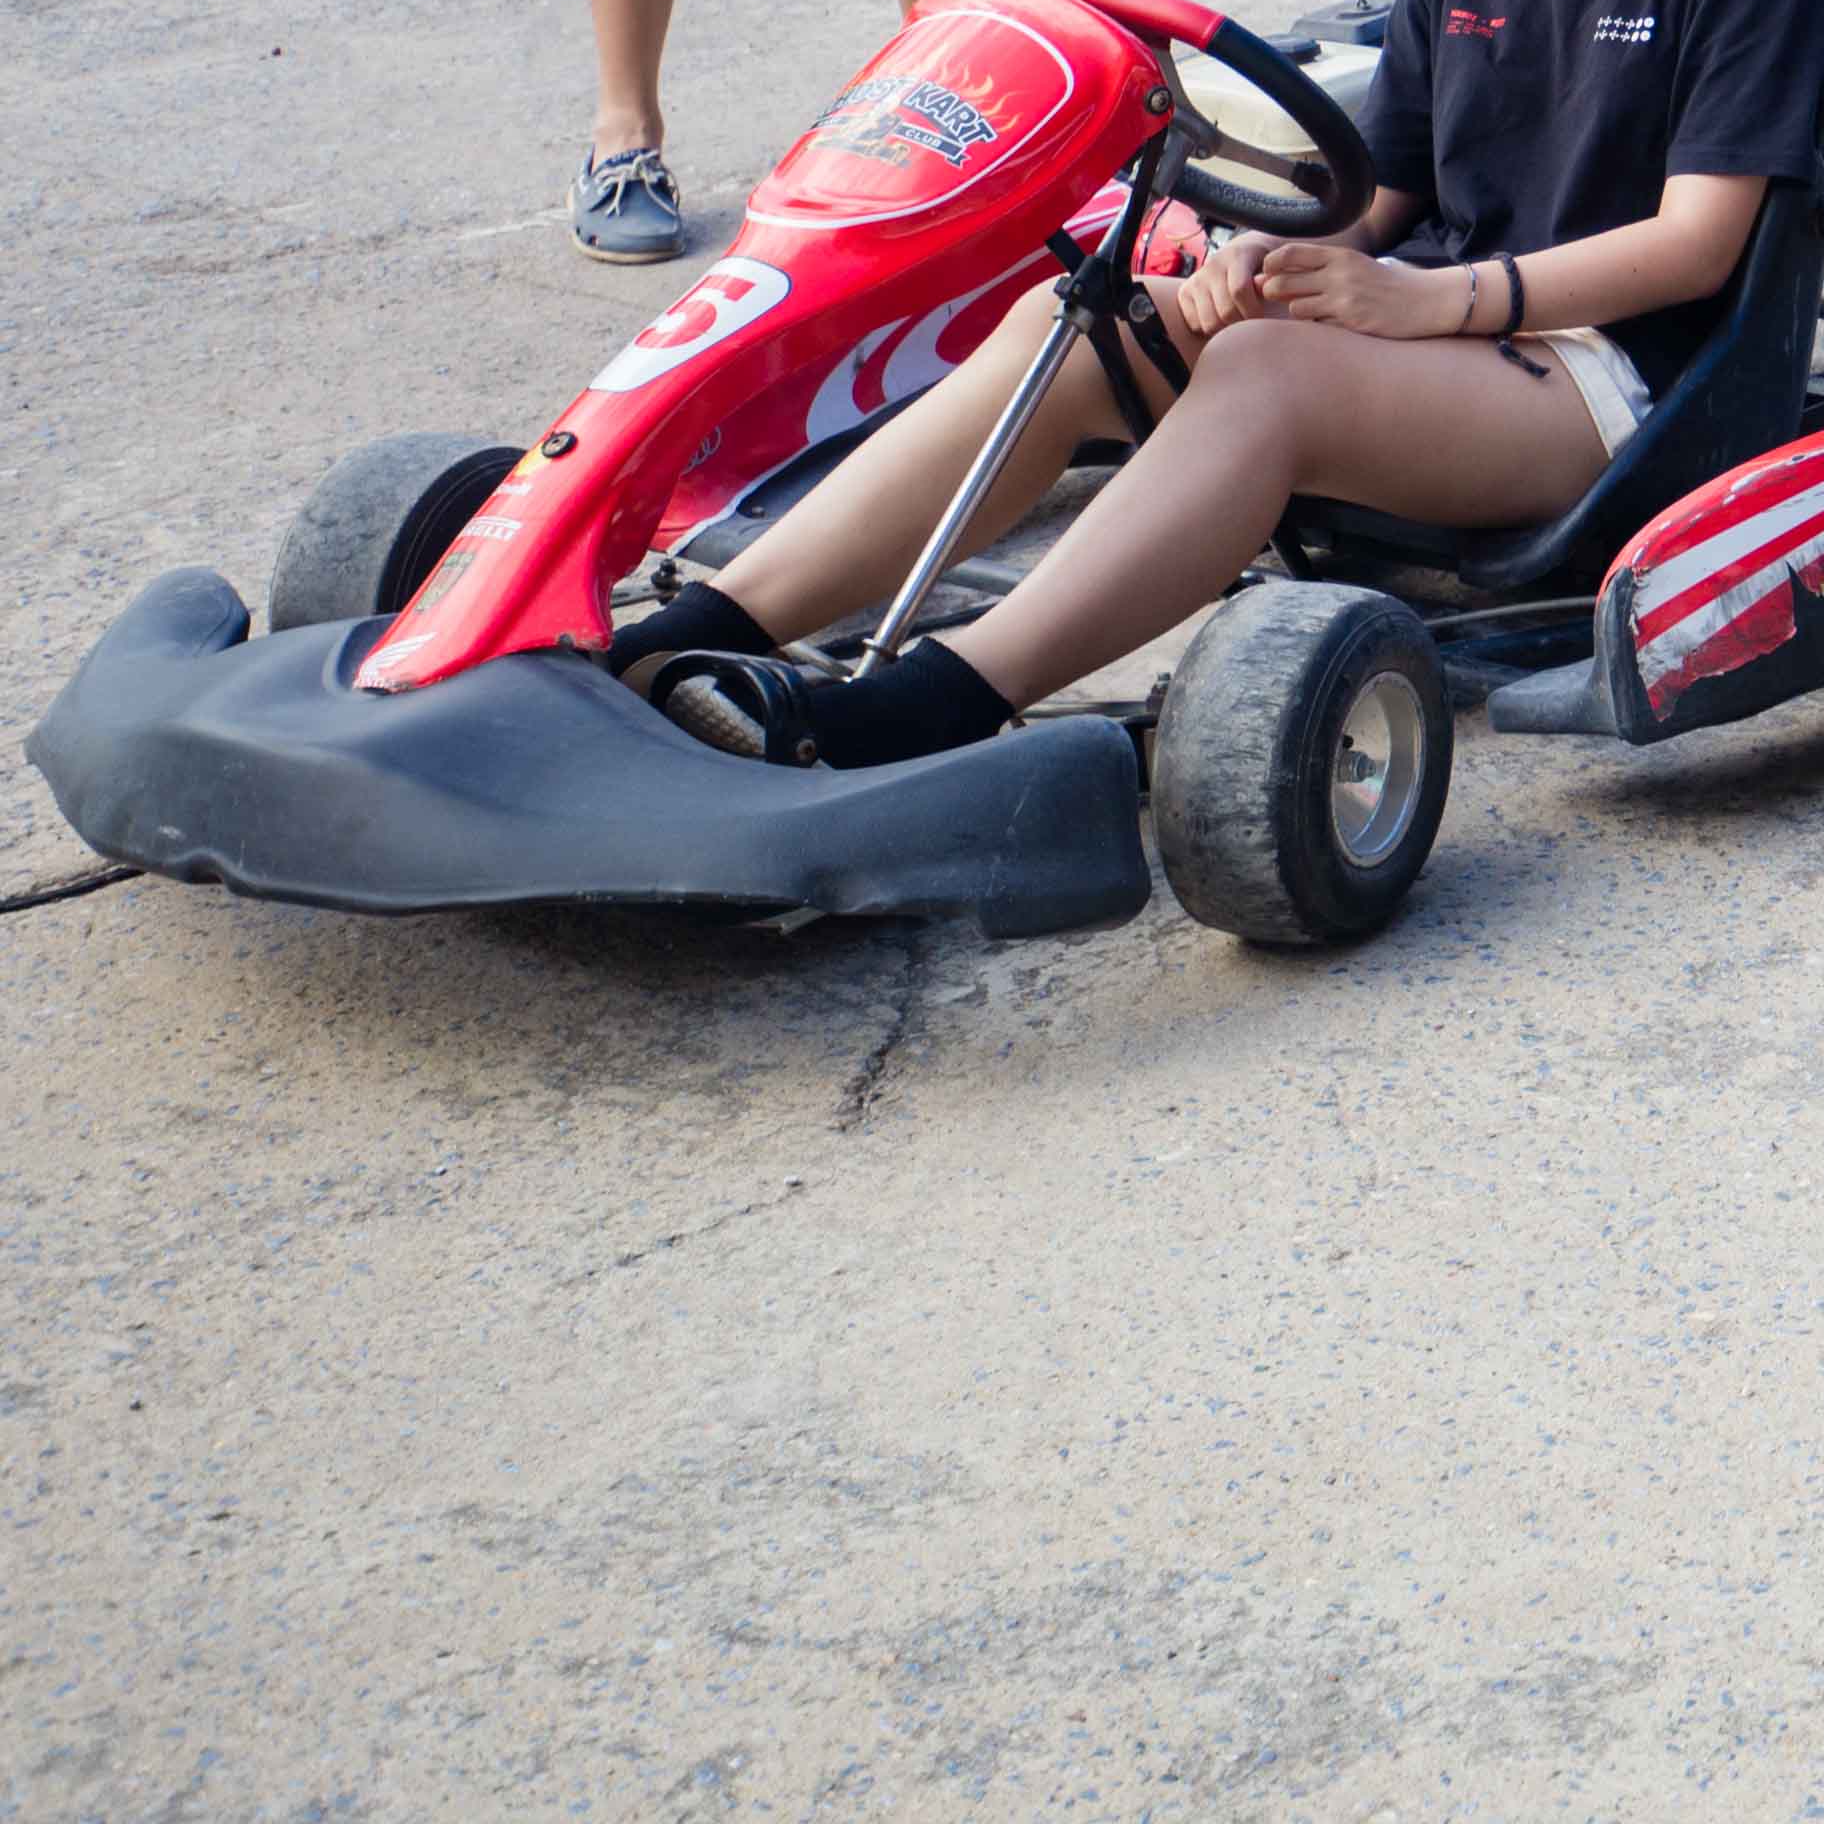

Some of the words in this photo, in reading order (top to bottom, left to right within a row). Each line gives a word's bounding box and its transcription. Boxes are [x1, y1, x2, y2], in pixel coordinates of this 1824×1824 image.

[903, 81, 998, 146] KART
[905, 128, 941, 147] CLUB
[634, 275, 756, 348] 5
